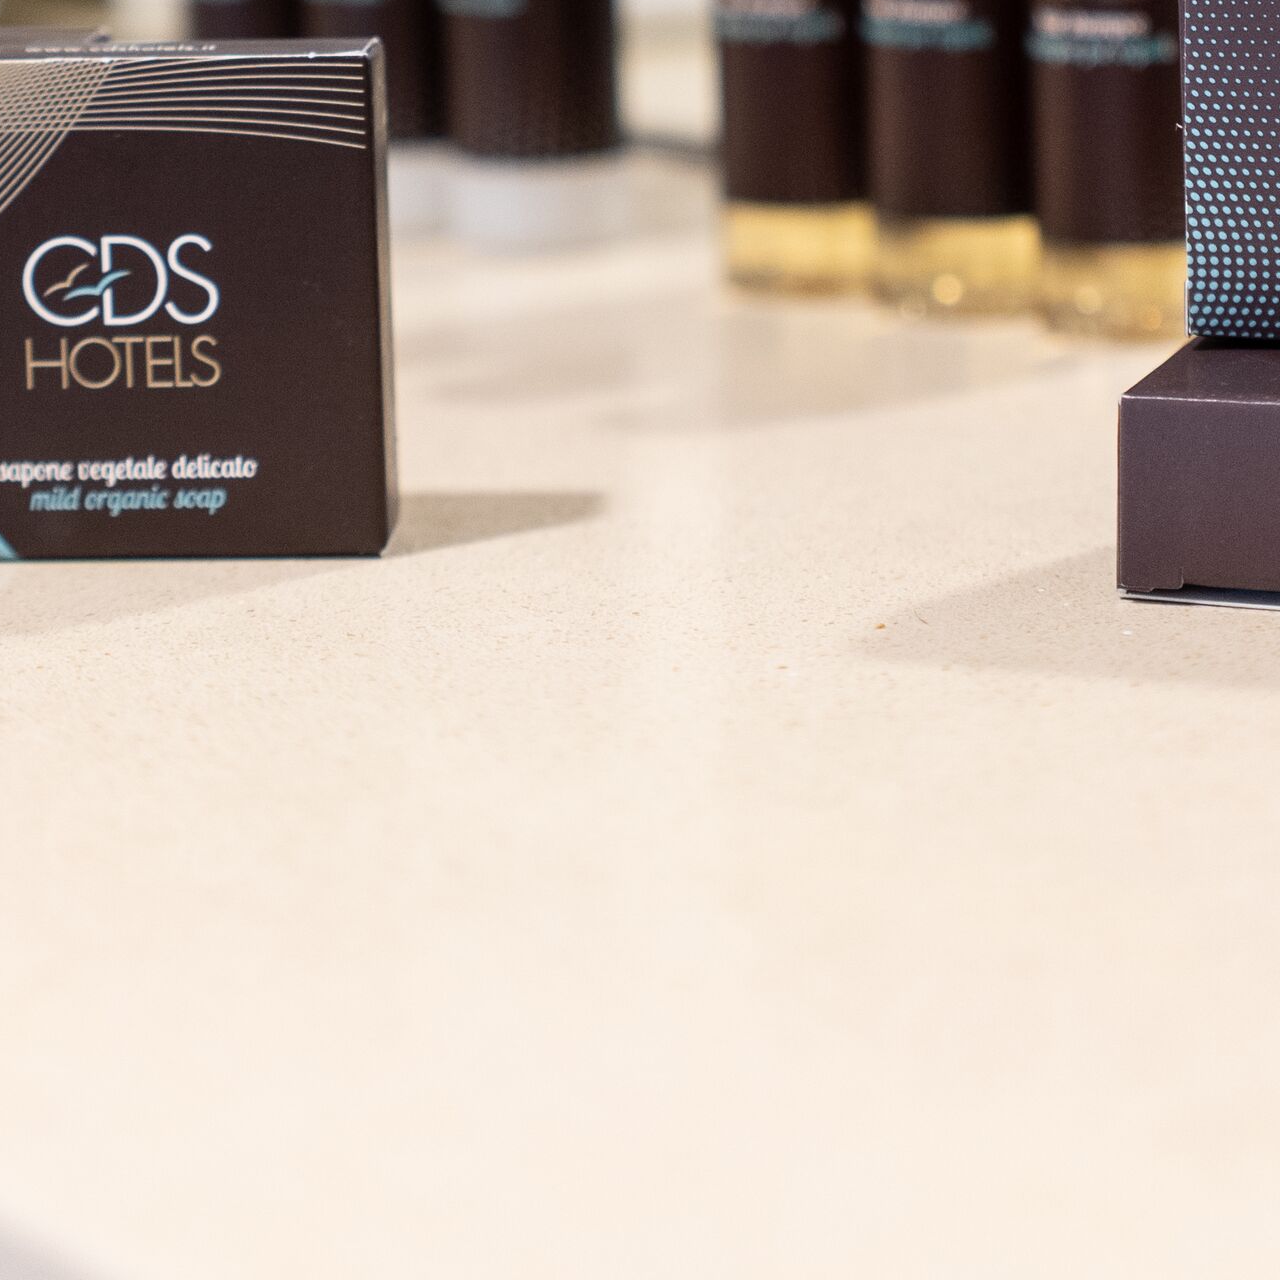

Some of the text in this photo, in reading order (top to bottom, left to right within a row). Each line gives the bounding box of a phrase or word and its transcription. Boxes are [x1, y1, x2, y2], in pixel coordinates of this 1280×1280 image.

[22, 234, 220, 326] CDS
[24, 335, 222, 390] HOTELS
[77, 454, 168, 488] vegetale
[171, 454, 258, 480] delicato
[29, 484, 228, 517] mild organic soap
